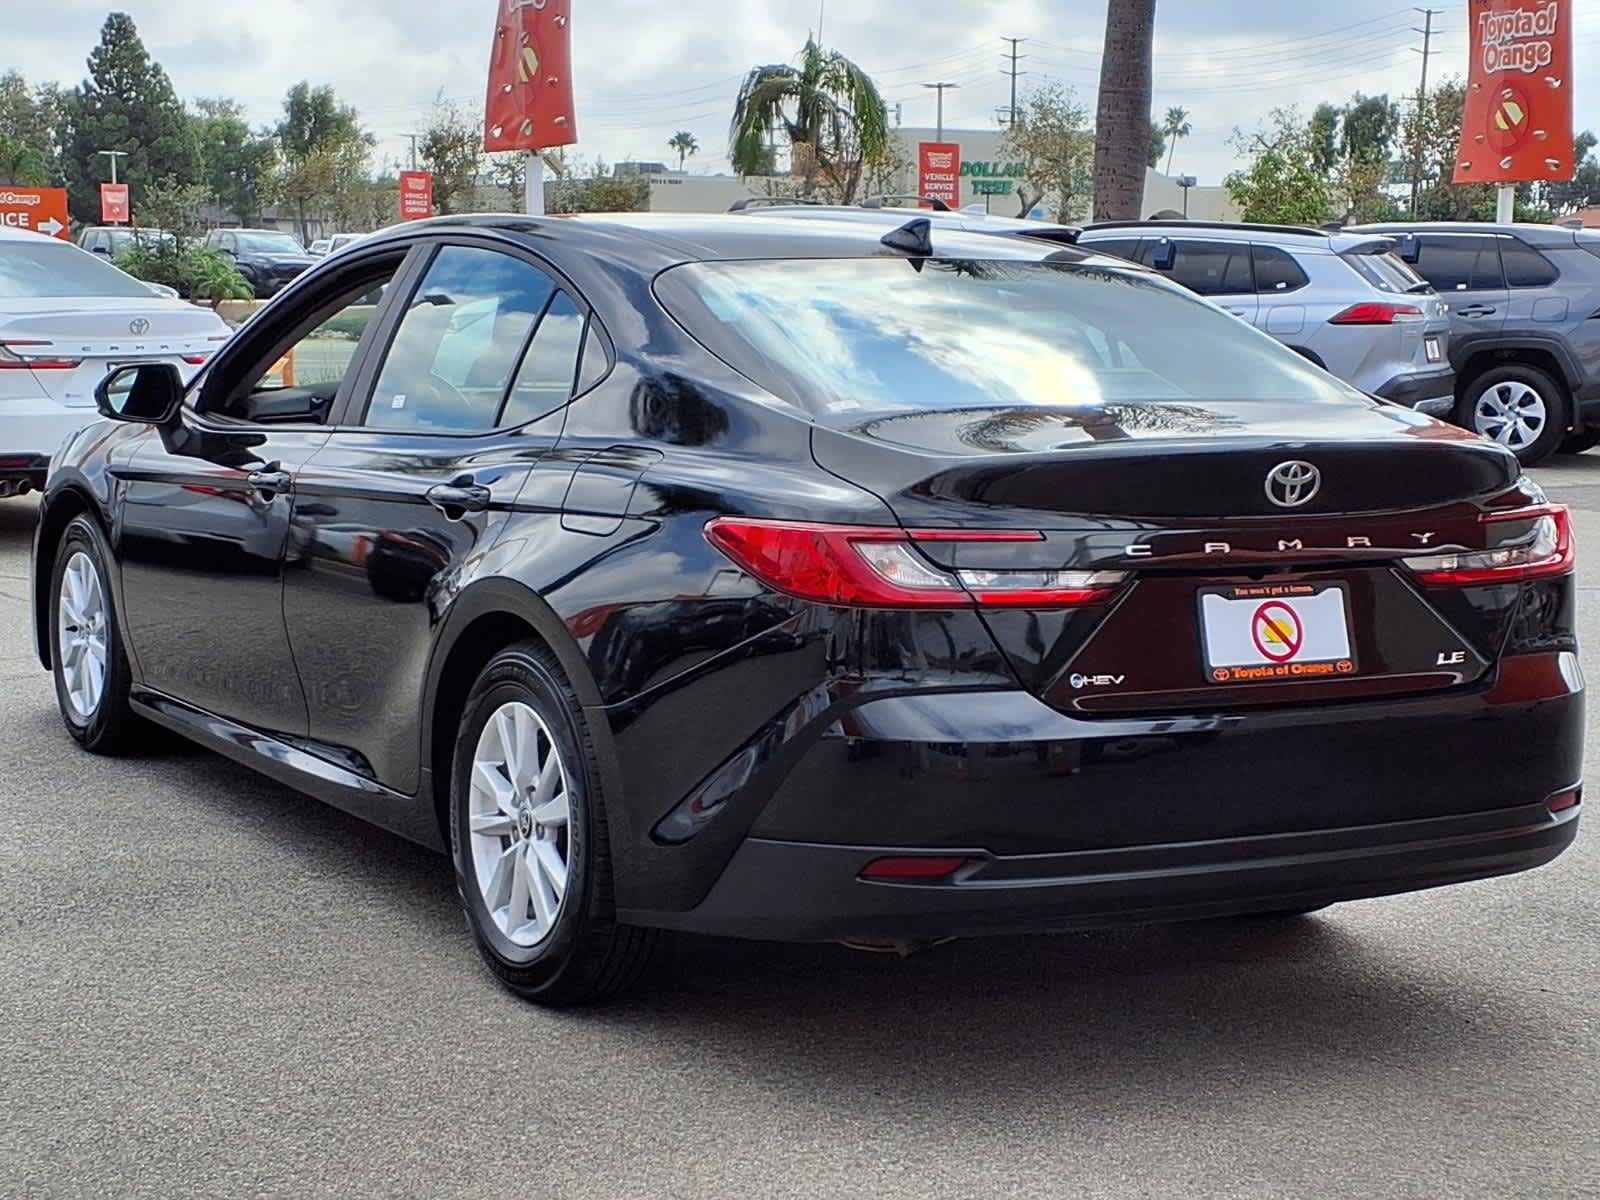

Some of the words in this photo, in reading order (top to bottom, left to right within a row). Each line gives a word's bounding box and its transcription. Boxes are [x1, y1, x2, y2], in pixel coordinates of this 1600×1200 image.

[1479, 8, 1535, 44] Toyota
[1535, 2, 1557, 35] of
[1483, 41, 1552, 73] Orange
[960, 161, 1025, 176] DOLLAR
[1126, 531, 1435, 556] CAMRY
[1436, 651, 1465, 665] LE
[1231, 667, 1274, 679] Toyota
[1275, 665, 1289, 675] of
[1291, 663, 1334, 675] Orange
